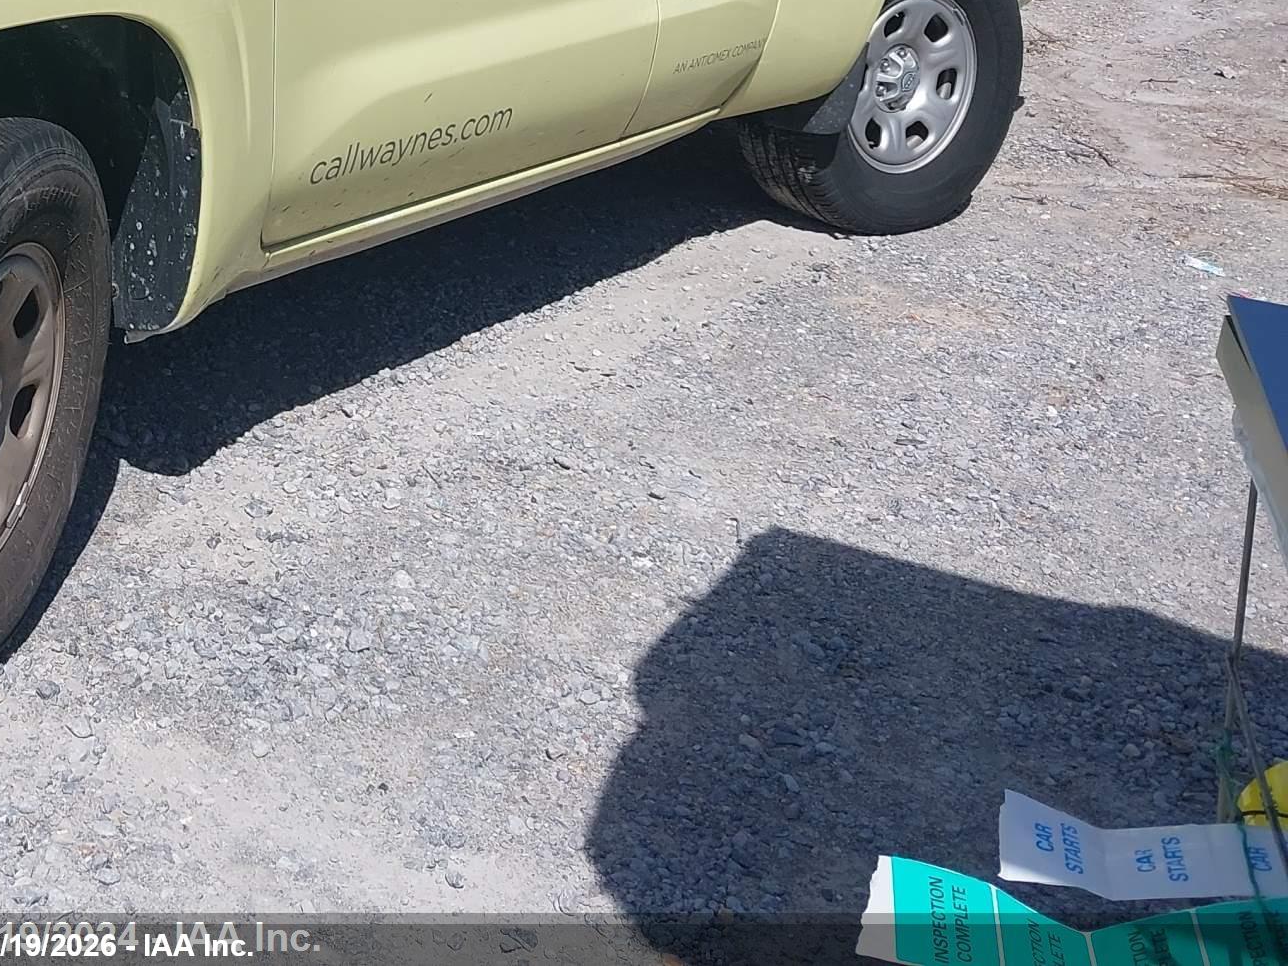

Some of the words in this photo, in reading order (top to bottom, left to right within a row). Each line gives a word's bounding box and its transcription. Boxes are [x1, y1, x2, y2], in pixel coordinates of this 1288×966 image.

[672, 60, 689, 75] AN
[308, 105, 514, 186] callwaynes.com
[1034, 822, 1055, 852] CAR
[1061, 822, 1085, 875] STARTS
[1134, 848, 1157, 873] CAR
[1162, 836, 1189, 882] STARTS
[927, 875, 950, 964] INSPECTION
[951, 884, 973, 963] COMPLETE
